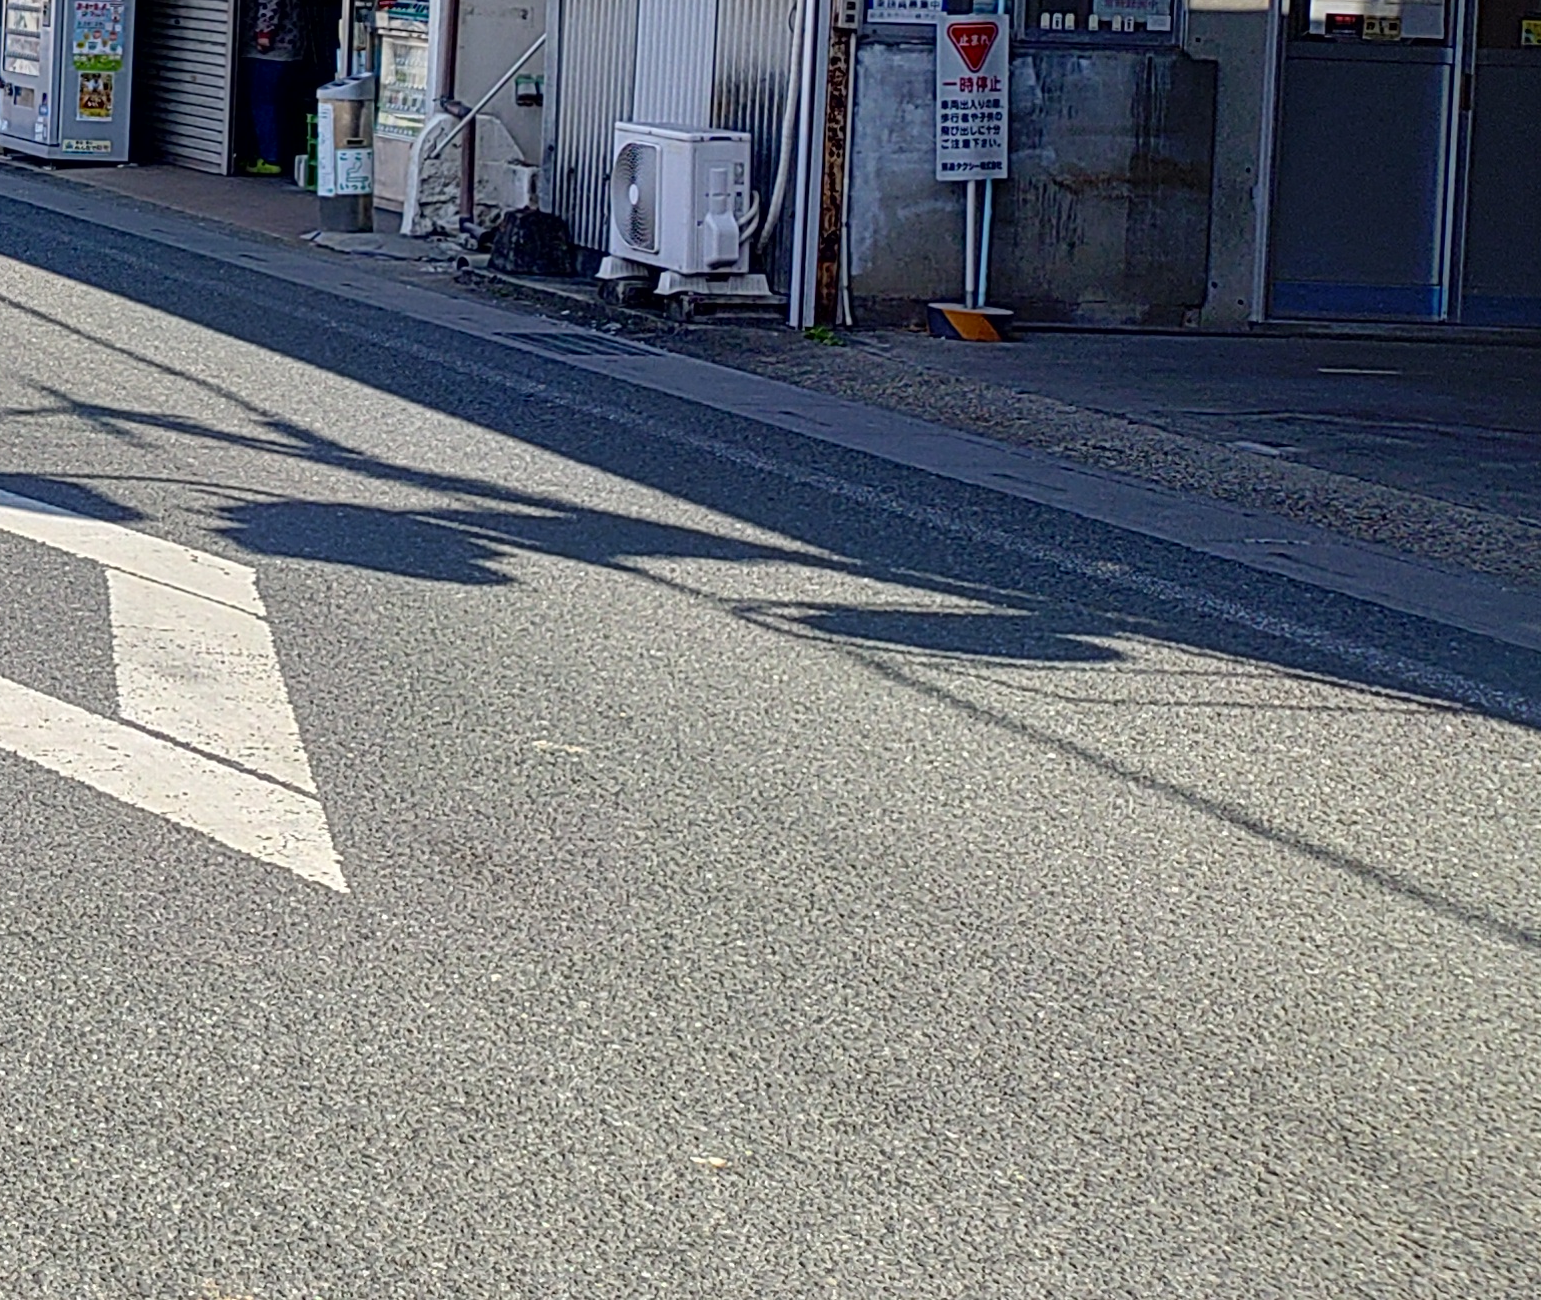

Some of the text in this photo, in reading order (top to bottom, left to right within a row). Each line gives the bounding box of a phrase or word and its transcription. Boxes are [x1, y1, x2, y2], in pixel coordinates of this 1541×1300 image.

[959, 34, 990, 47] 止まれ
[942, 76, 1002, 93] 一時停止
